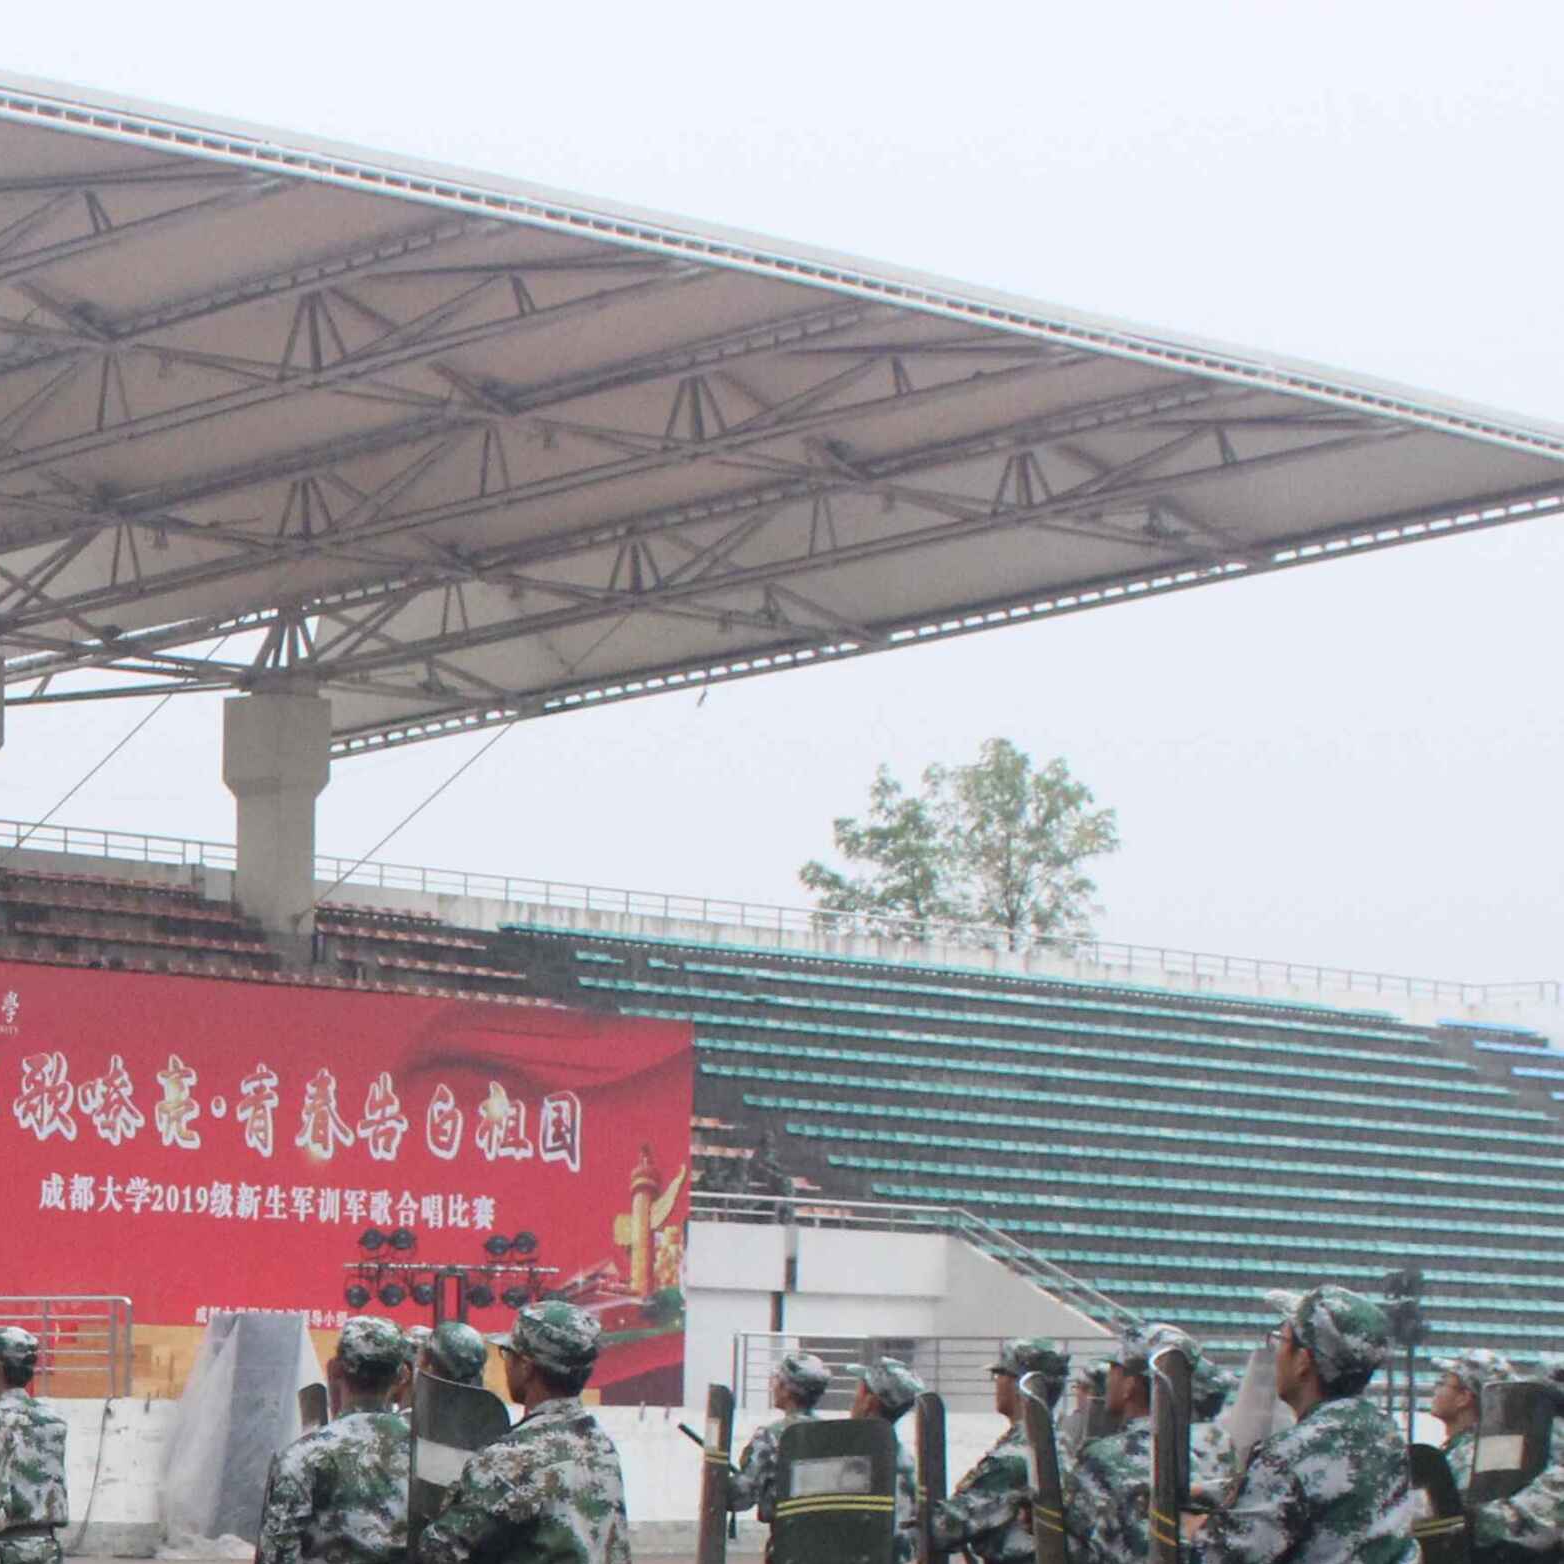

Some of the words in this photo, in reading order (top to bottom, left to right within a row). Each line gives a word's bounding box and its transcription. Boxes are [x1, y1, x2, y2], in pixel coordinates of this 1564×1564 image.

[38, 1172, 495, 1230] 成都大学2019级新生军训军歌合唱比赛
